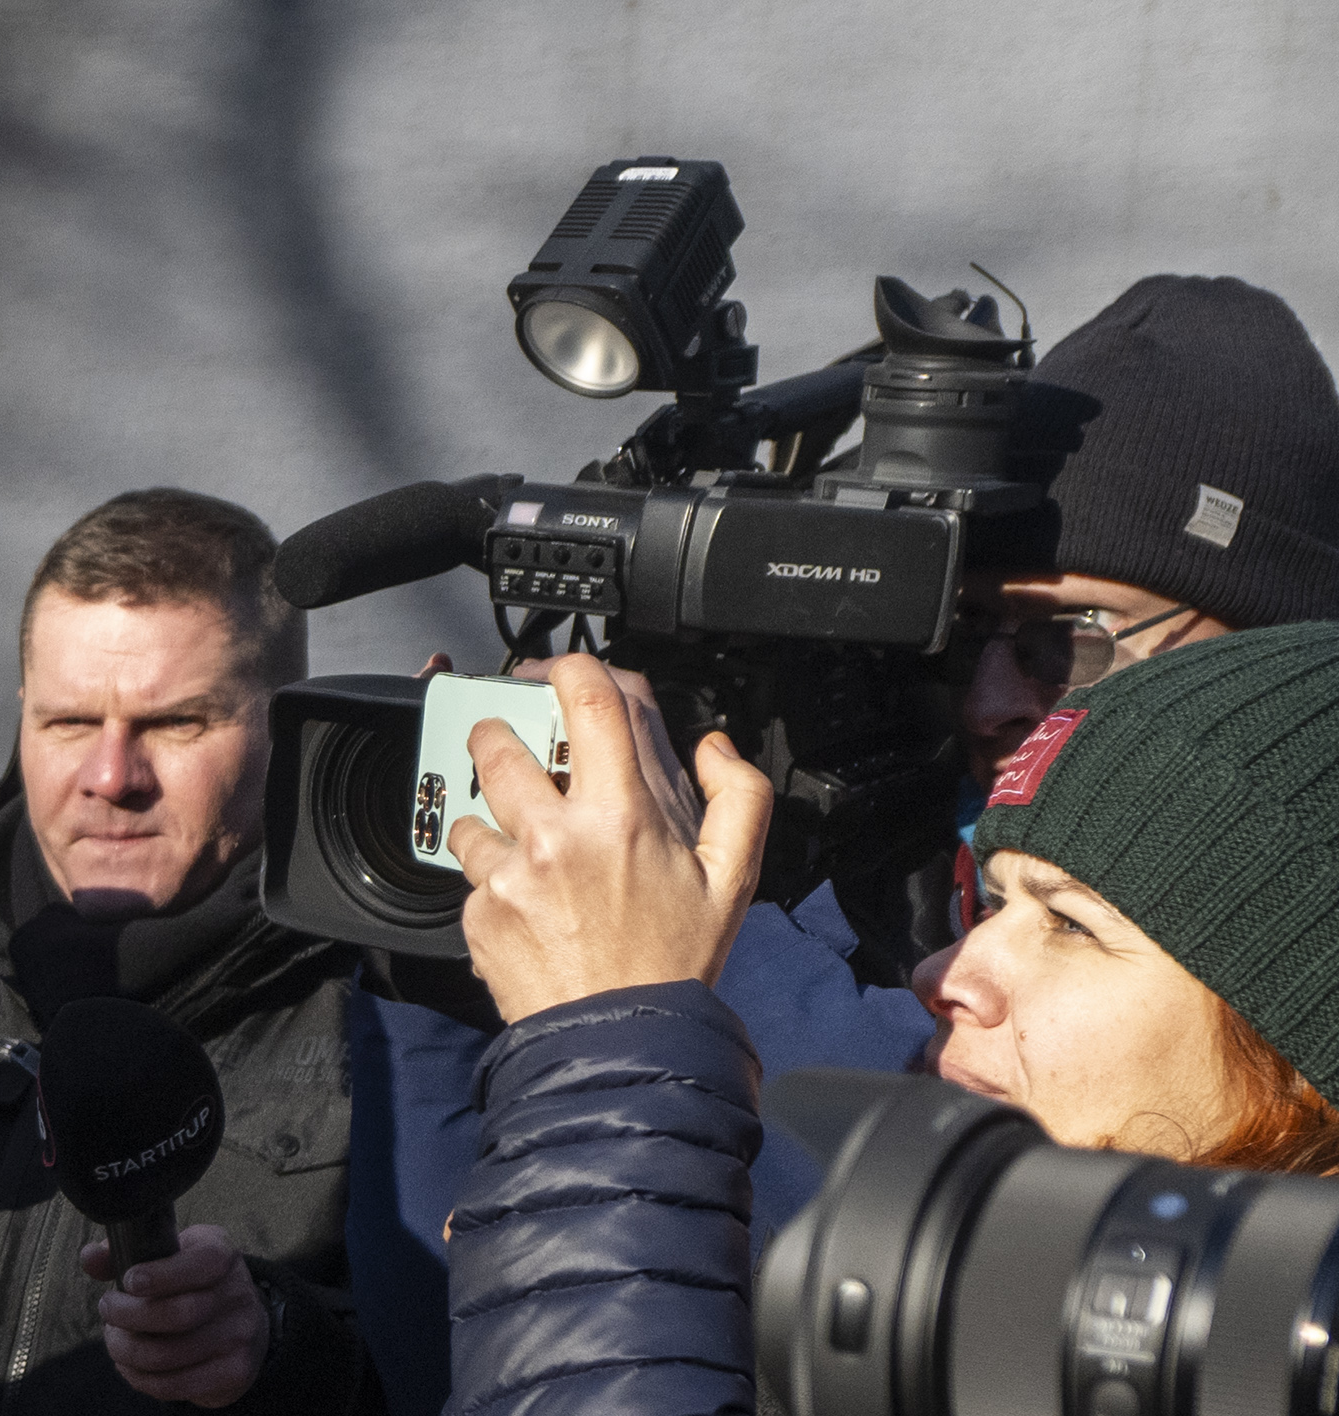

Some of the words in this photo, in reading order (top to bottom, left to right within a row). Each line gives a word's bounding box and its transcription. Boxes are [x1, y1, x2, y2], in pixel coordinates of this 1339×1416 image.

[562, 513, 615, 529] SONY
[767, 562, 843, 581] XDCAM
[850, 567, 881, 583] HD
[93, 1105, 211, 1182] STARTITUP
